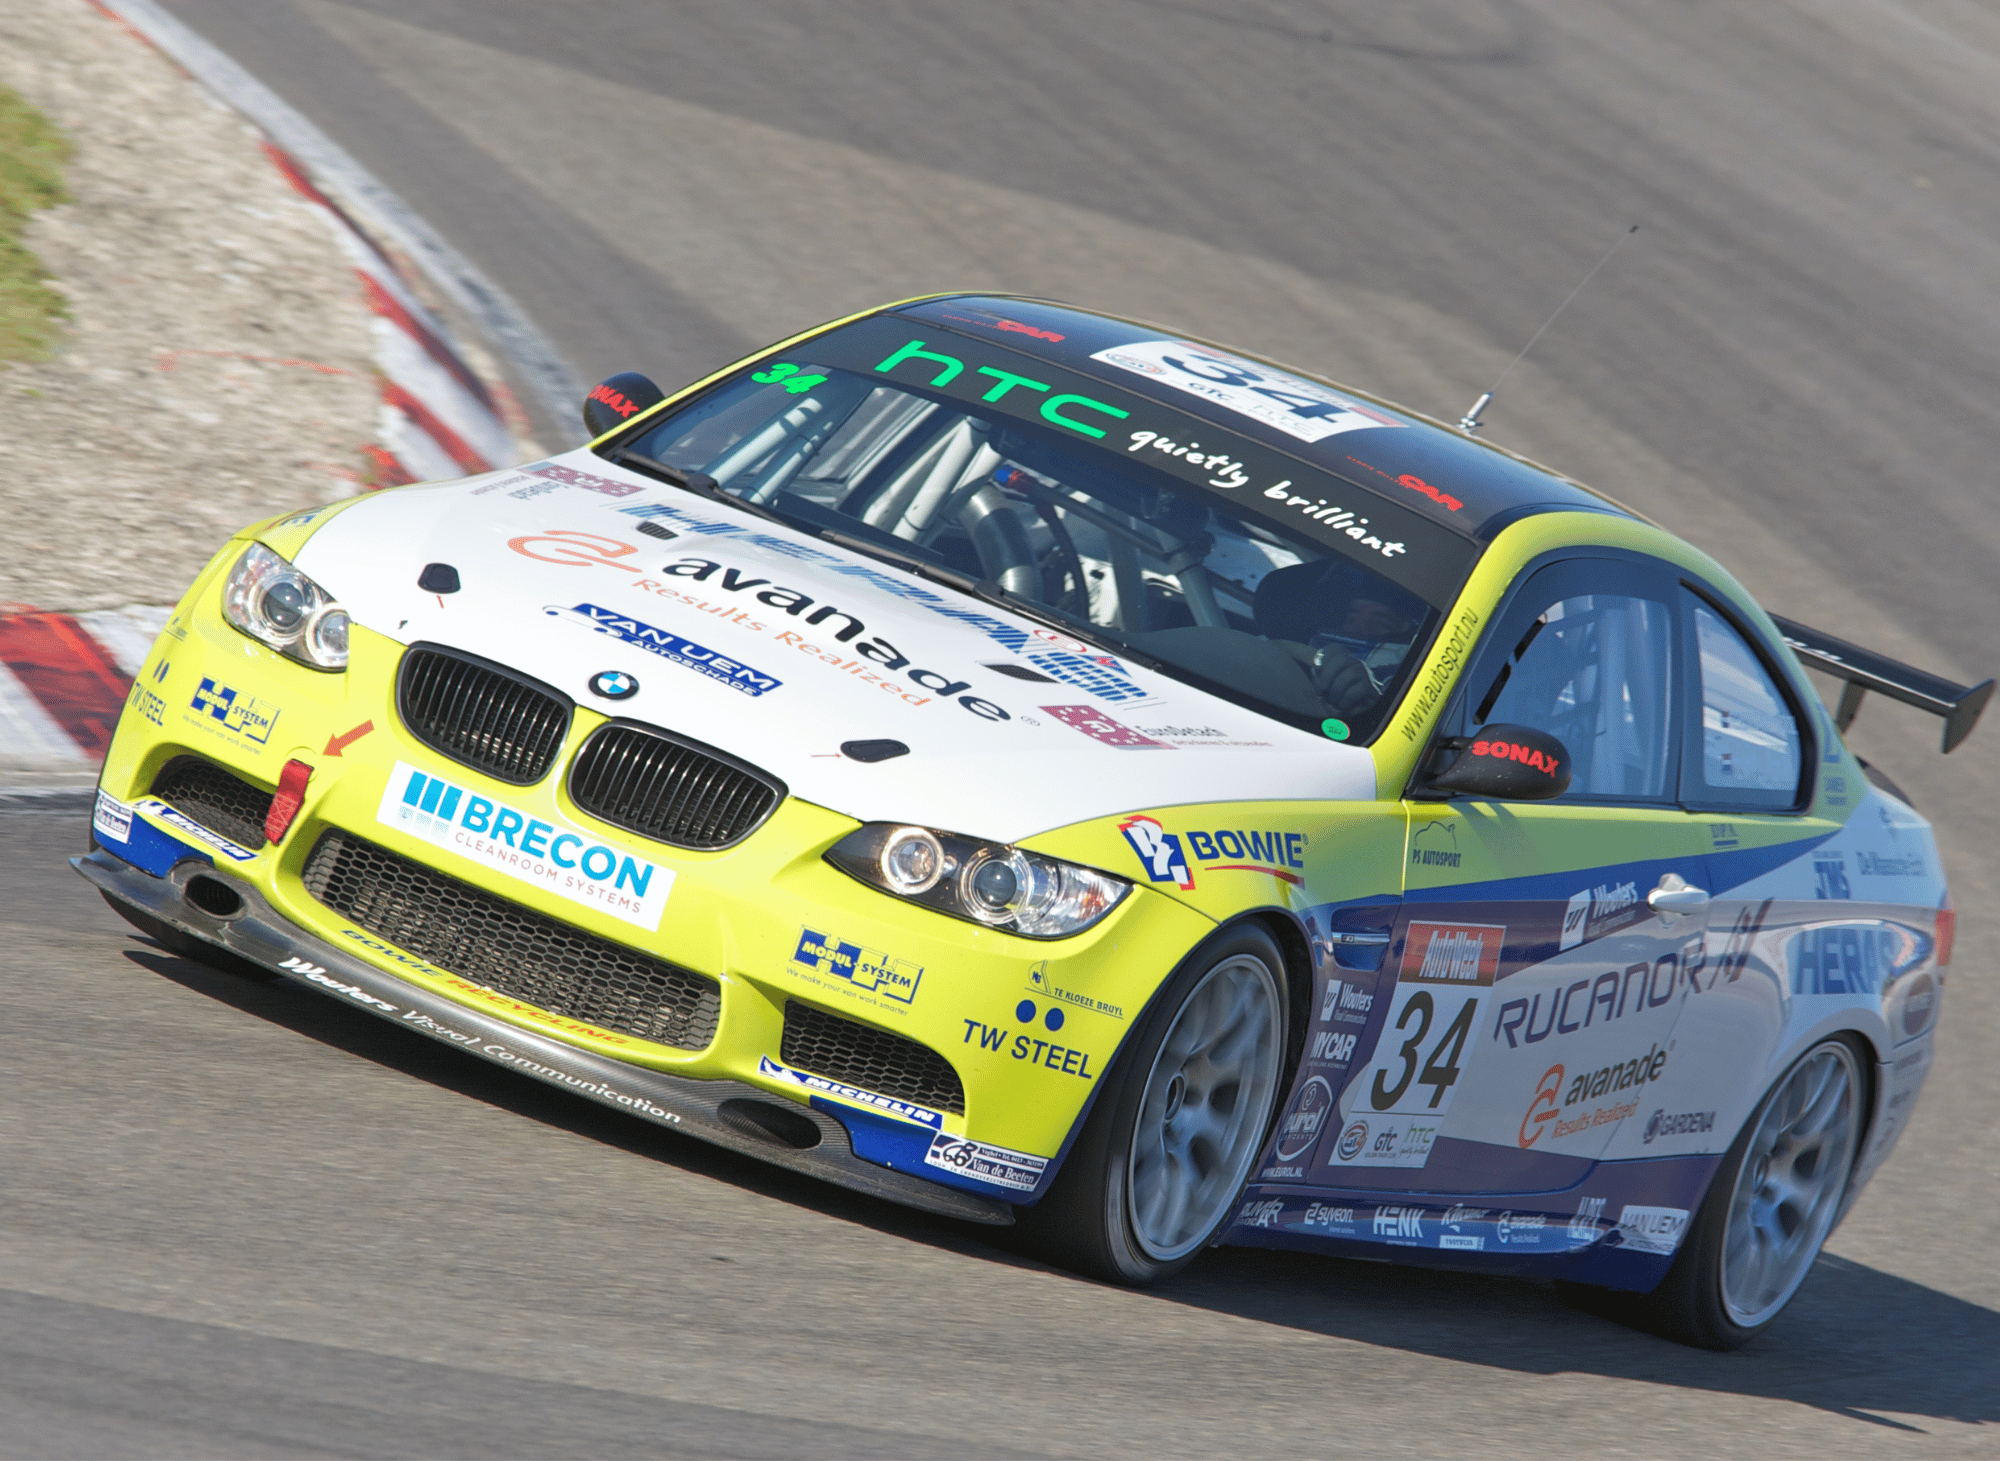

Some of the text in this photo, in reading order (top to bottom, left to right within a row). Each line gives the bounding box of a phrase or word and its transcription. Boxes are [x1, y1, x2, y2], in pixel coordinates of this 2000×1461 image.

[751, 363, 828, 394] 34
[1161, 353, 1351, 423] 34
[1128, 430, 1406, 557] quietly brilliant
[590, 607, 775, 690] VAN UEM
[630, 639, 757, 696] AUTOSCHADE
[631, 578, 932, 707] Results Realized
[662, 557, 1011, 722] avanade
[1401, 607, 1479, 742] www.autosport.nu
[1472, 740, 1559, 778] SONAX
[455, 832, 642, 913] CLEANROOM SYSTEMS
[461, 795, 654, 898] BRECON
[1186, 830, 1304, 868] BOWIE
[1412, 849, 1462, 868] PS AUTOSPORT
[1593, 881, 1639, 919] Wouters
[340, 929, 628, 1044] BOWIE RECYCLING
[786, 967, 908, 1016] We make your van work smarter
[802, 941, 911, 988] MODUL SYSTEM
[1054, 987, 1123, 1016] TE KLOEZE BRUYL
[1339, 983, 1373, 1012] Wouters
[1494, 942, 1707, 1049] RUCANOR
[277, 956, 682, 1123] Wouters Visual Communication
[963, 1019, 1093, 1079] TW STEEL
[1370, 990, 1479, 1111] 34
[805, 1077, 935, 1122] MICHELIN
[1565, 1043, 1667, 1106] avanade
[973, 1159, 1035, 1184] Van de Beeten
[1373, 1206, 1426, 1238] HENK
